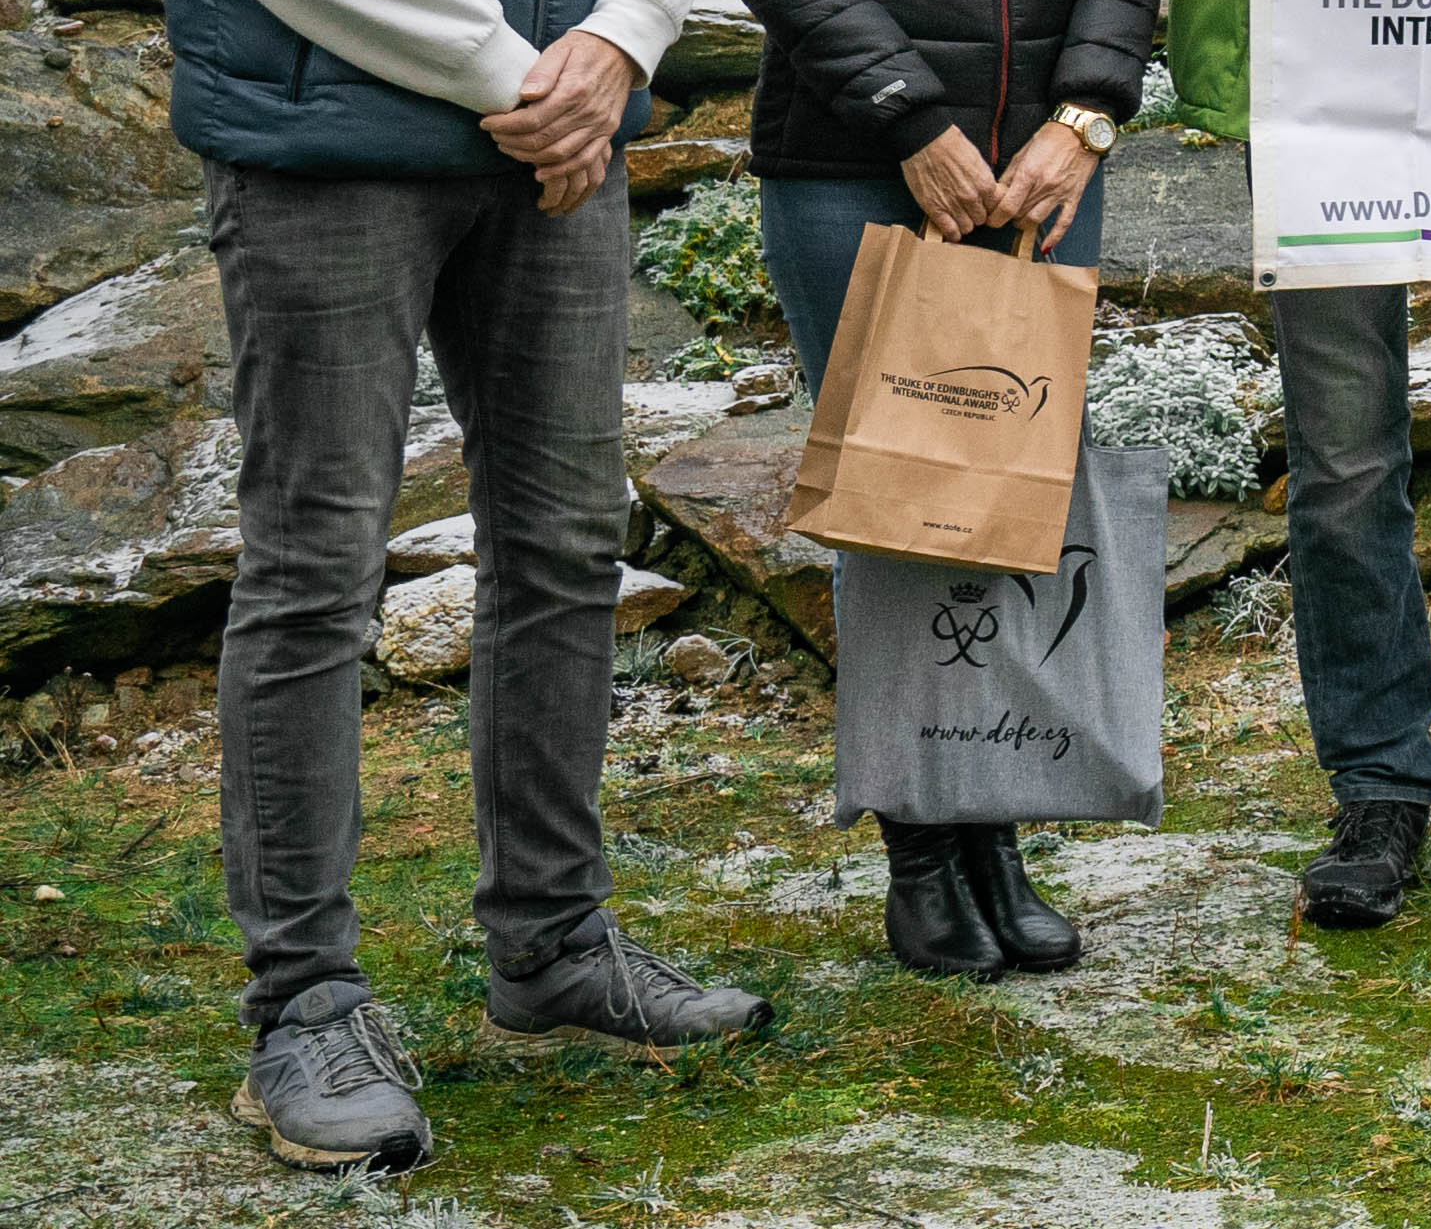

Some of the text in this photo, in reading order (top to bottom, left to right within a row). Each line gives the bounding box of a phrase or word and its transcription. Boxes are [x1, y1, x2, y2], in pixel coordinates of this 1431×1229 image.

[881, 373, 999, 400] THE DUKE OF EDINBURGH'S
[892, 386, 998, 411] INTERNATIONAL AWARD
[941, 408, 996, 421] CZECH REPUBLIC
[920, 710, 1078, 760] www.dofe.cz
